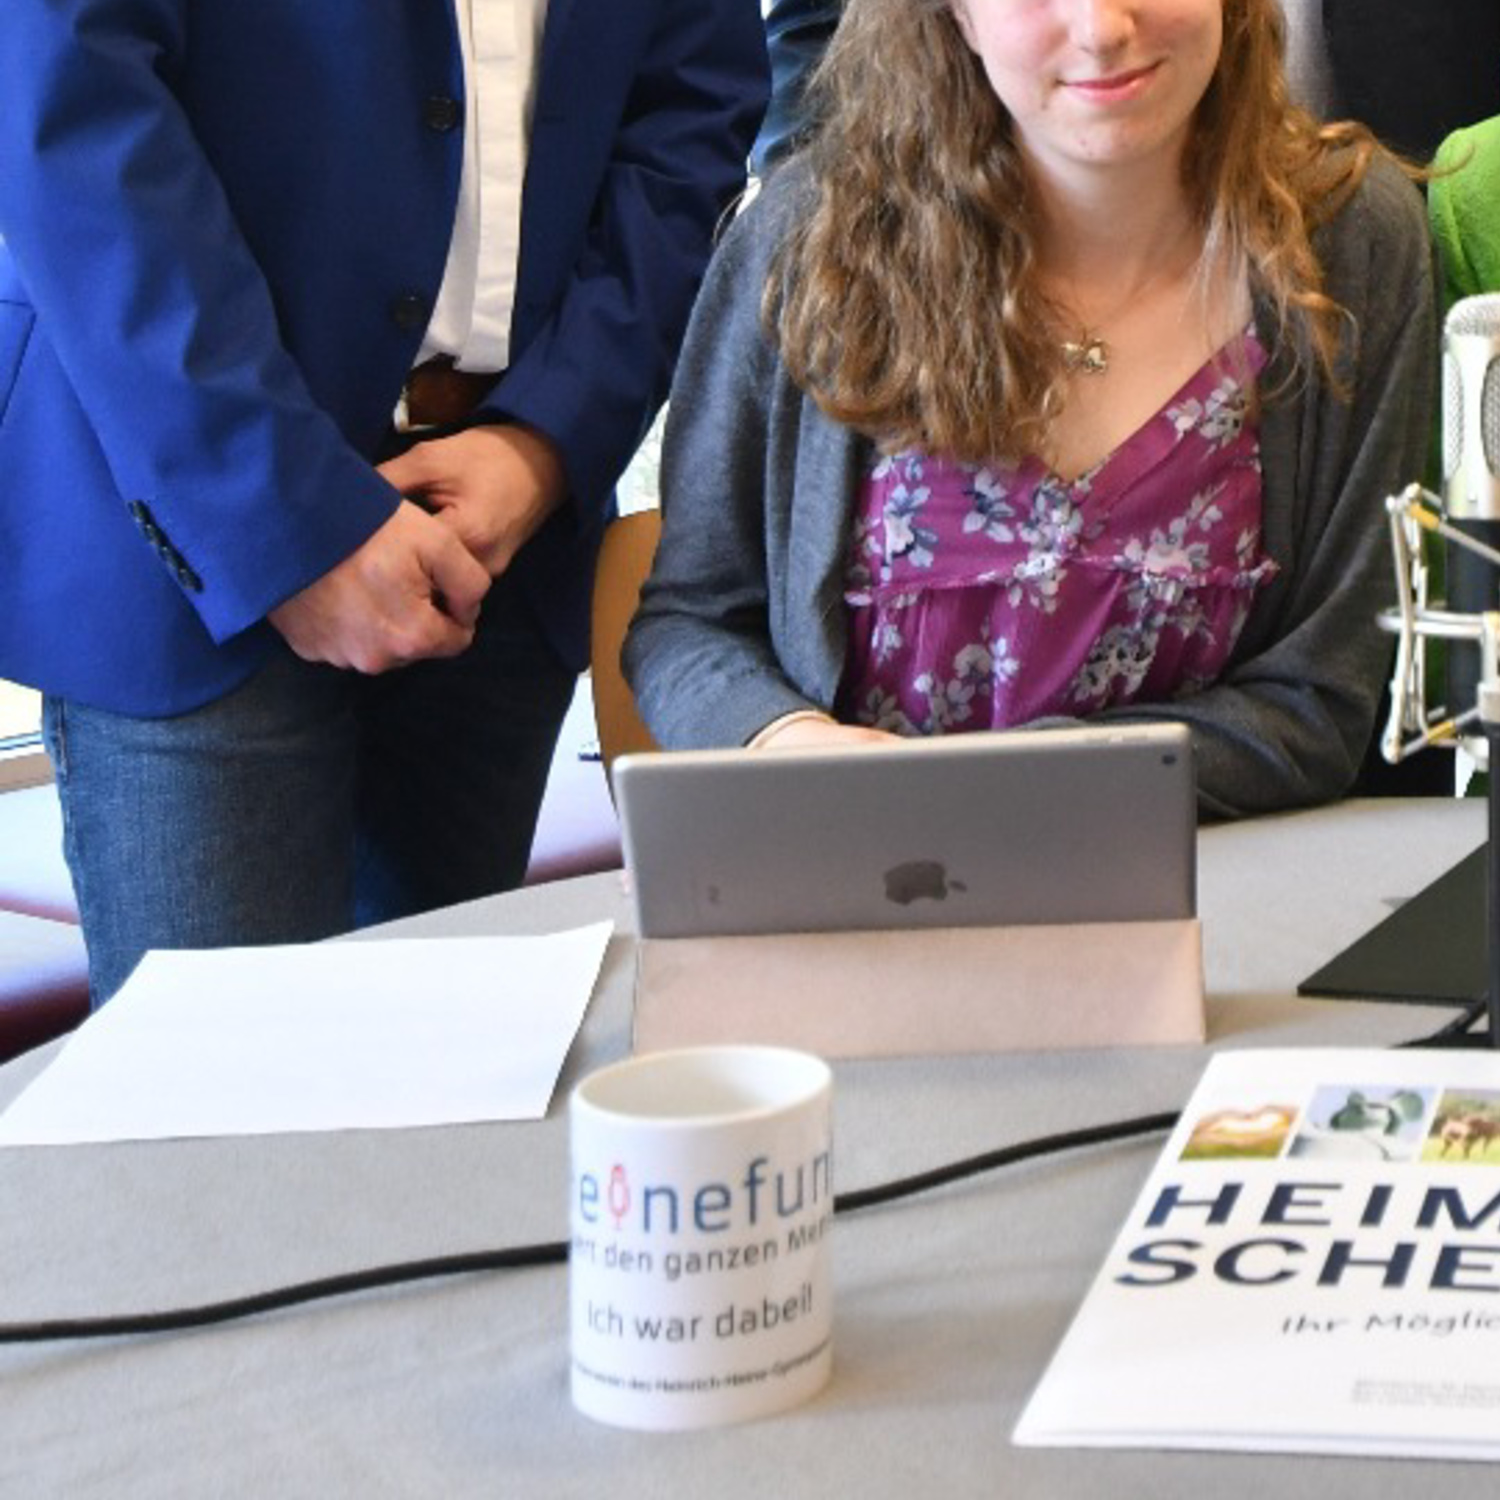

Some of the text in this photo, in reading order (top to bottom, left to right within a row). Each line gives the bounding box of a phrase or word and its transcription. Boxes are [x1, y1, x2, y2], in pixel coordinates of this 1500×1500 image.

[603, 1242, 655, 1274] den
[664, 1238, 778, 1281] ganzen
[587, 1282, 814, 1342] Ich war dabei!
[1280, 1313, 1349, 1336] Ihr
